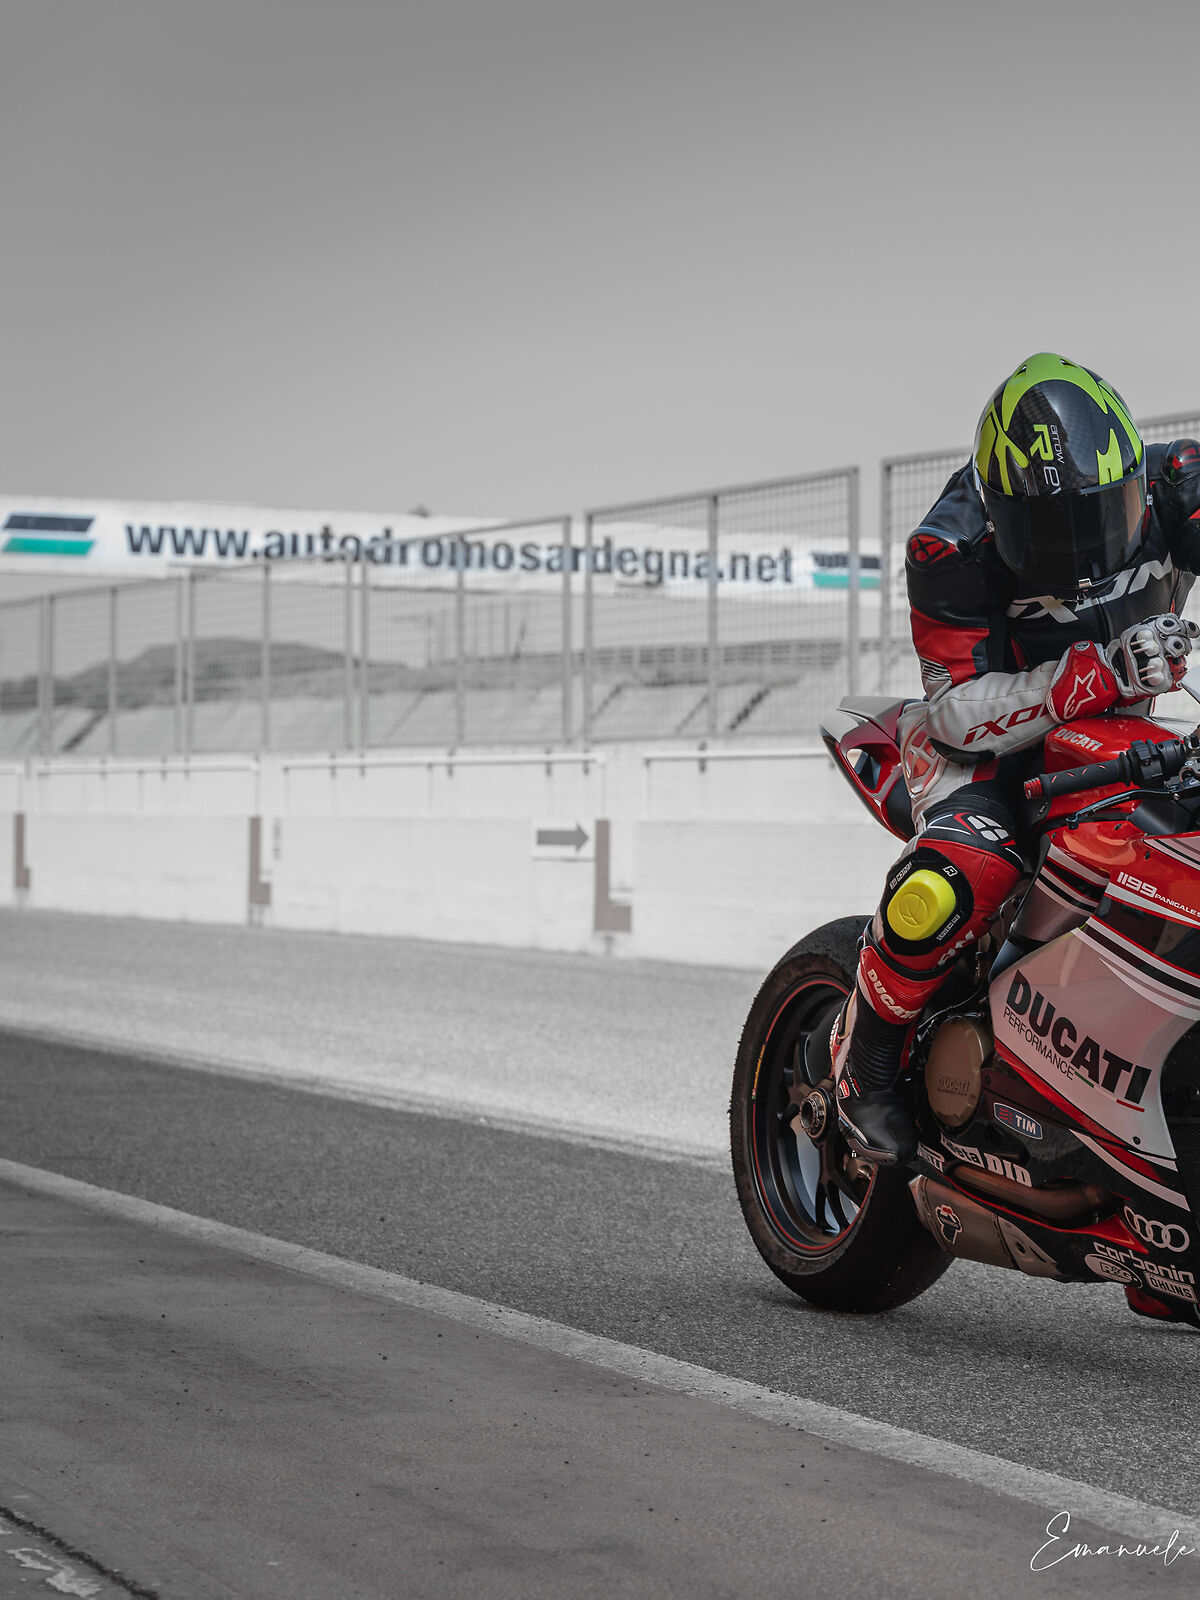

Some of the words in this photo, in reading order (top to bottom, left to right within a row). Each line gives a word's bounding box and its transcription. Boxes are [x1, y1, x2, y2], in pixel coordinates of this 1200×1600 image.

[125, 523, 794, 588] www.autodromosardegna.net
[962, 703, 1048, 746] IXO
[1054, 728, 1104, 752] DUCATI
[1117, 871, 1158, 898] 1199
[1003, 1006, 1076, 1081] PERFORMANCE
[1005, 969, 1152, 1105] DUCATI
[1015, 1114, 1036, 1135] TIM
[983, 1152, 1032, 1188] DID
[1093, 1241, 1195, 1284] carbonin
